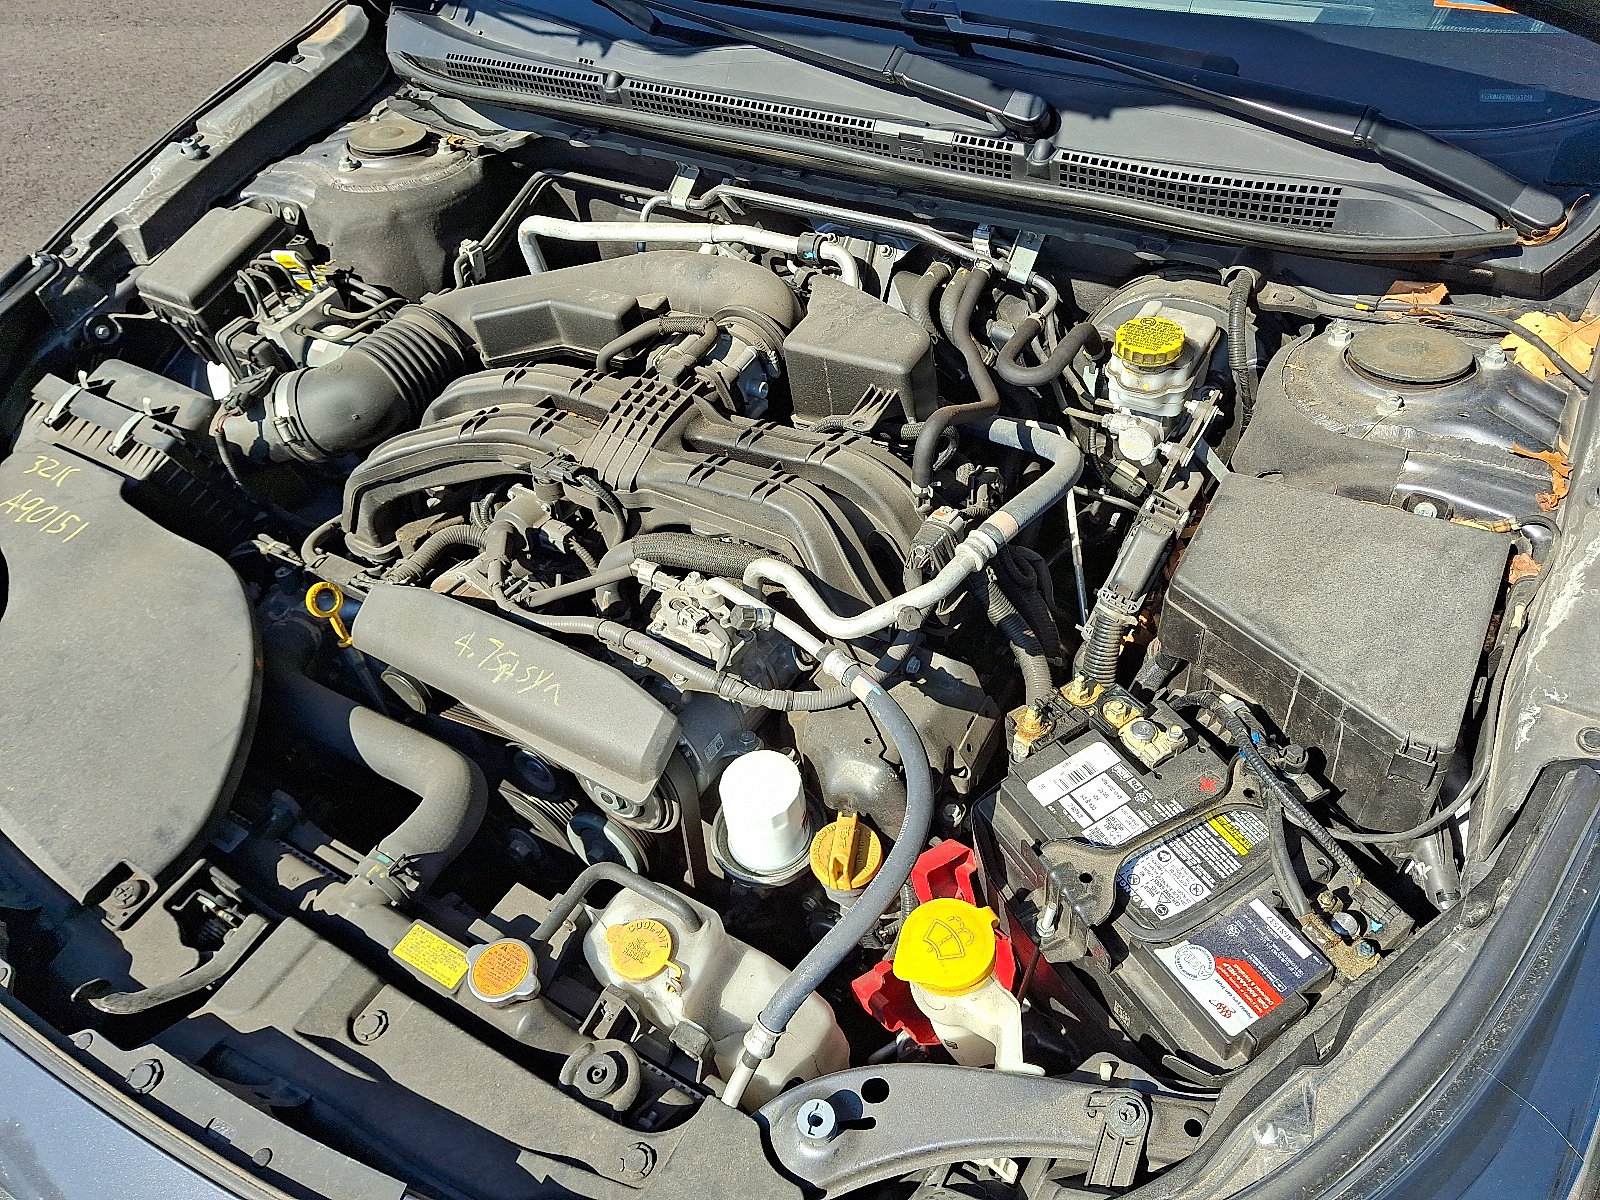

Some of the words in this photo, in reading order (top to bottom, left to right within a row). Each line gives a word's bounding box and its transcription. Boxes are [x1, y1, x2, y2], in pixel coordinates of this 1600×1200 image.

[0, 489, 89, 543] A90151
[1129, 779, 1140, 789] Pb
[1113, 874, 1141, 903] DANGE
[627, 920, 670, 949] COOLANT
[1177, 943, 1210, 979] AGM
[1214, 978, 1225, 989] trust
[1253, 985, 1274, 1005] Delivered
